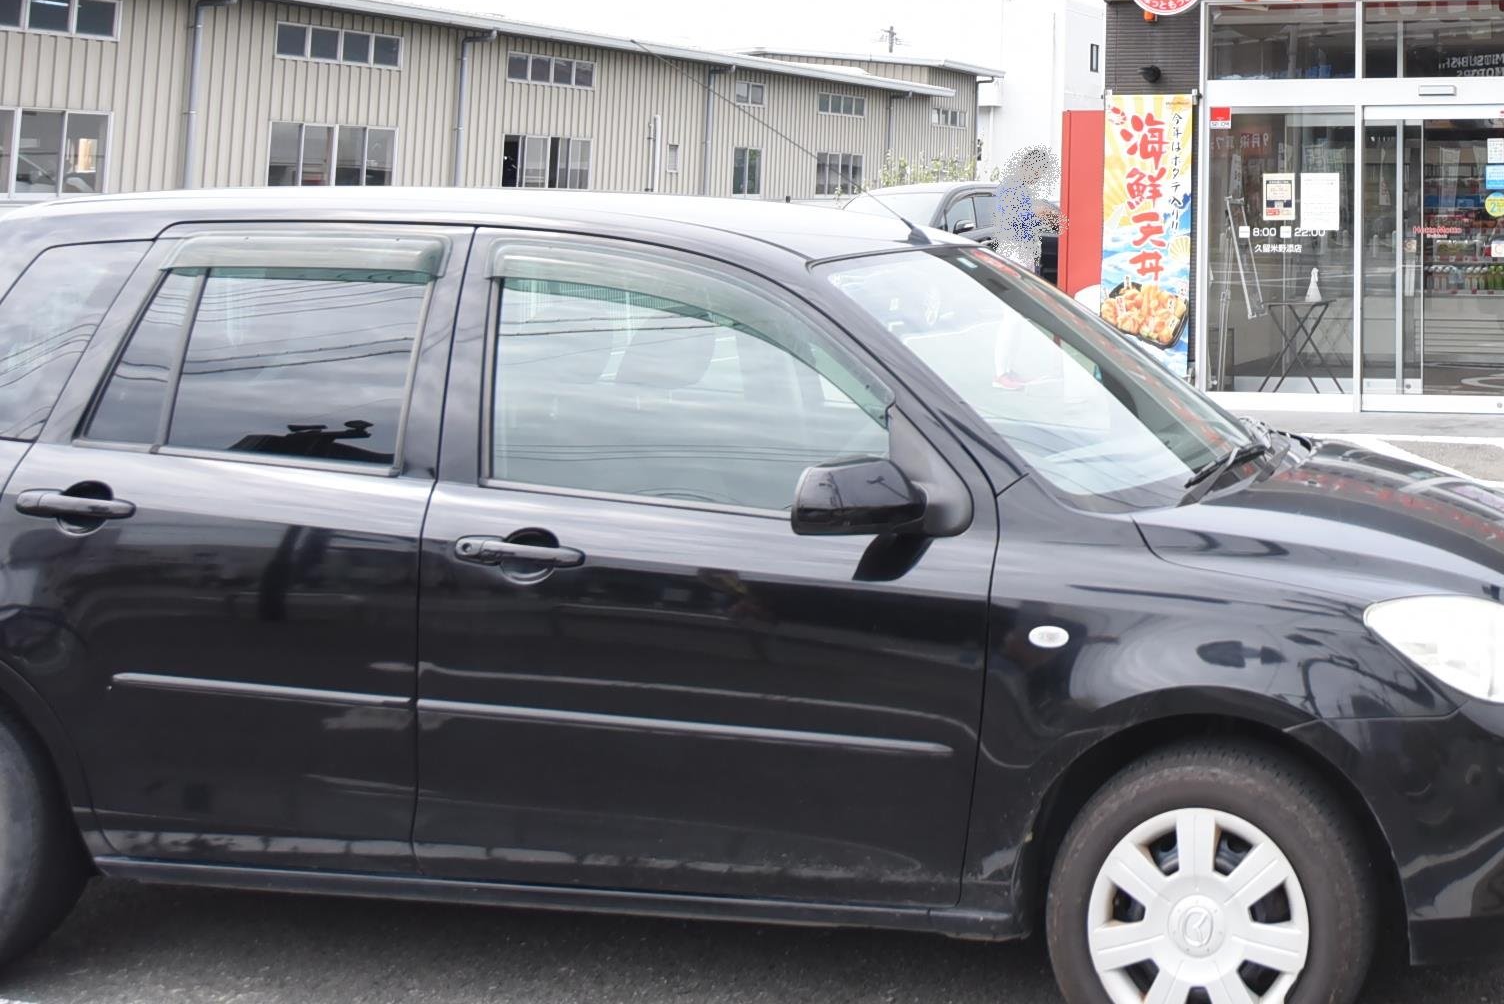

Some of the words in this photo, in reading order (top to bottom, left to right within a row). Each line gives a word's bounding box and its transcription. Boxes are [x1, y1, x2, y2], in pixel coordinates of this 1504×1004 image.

[1119, 112, 1170, 281] 海鮮天丼
[1252, 227, 1277, 237] 8:00
